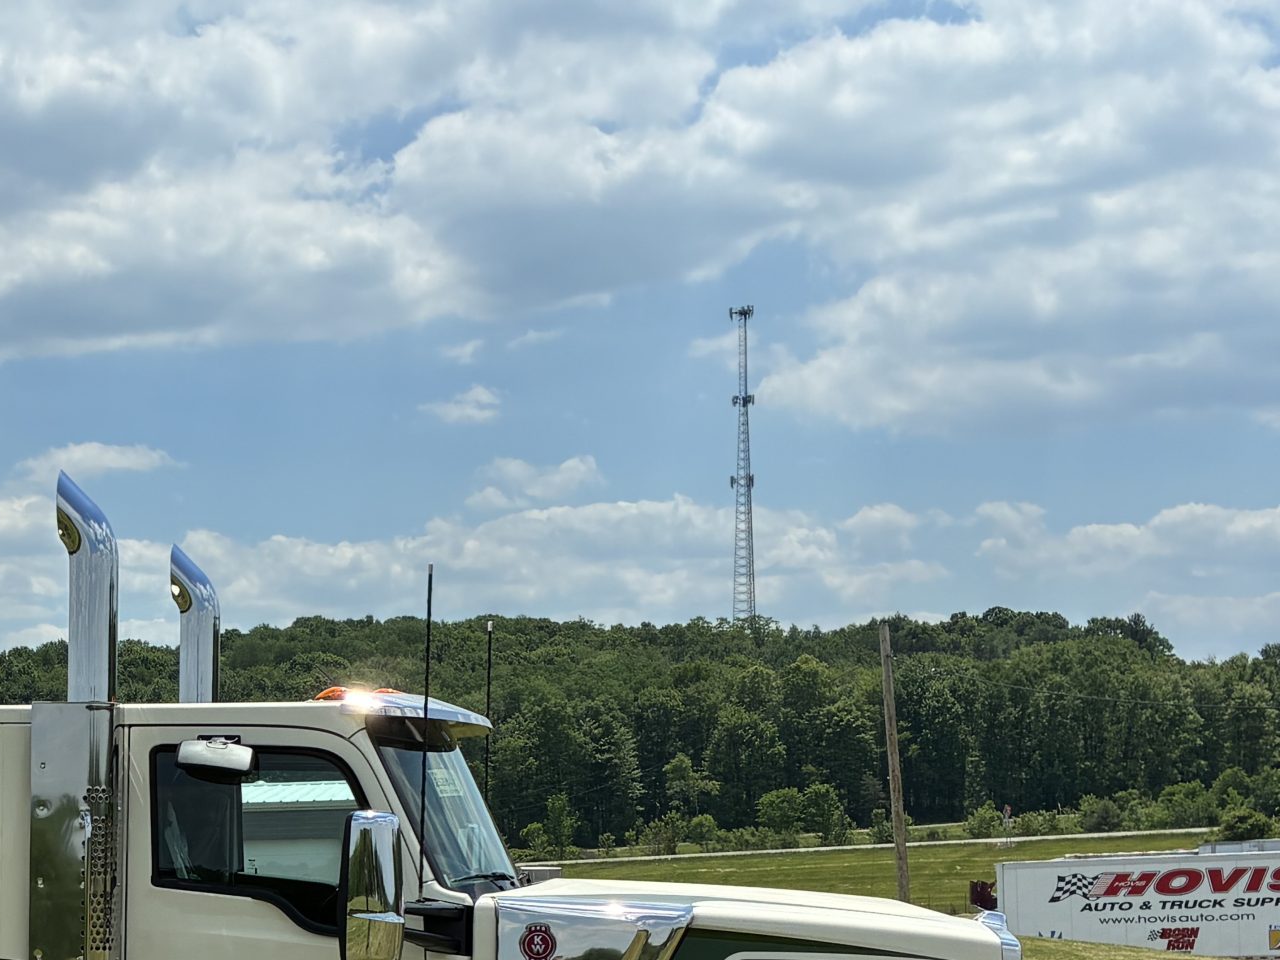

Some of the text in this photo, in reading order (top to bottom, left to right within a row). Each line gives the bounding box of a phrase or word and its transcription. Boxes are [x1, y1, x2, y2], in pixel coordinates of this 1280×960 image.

[1080, 902, 1133, 912] AUTO
[1139, 901, 1152, 910] &
[1159, 899, 1225, 909] TRUCK
[1098, 912, 1256, 924] www.hovisauto.com
[1159, 927, 1200, 939] BORN
[534, 935, 542, 944] K
[1166, 938, 1196, 950] RUN
[531, 944, 545, 953] W
